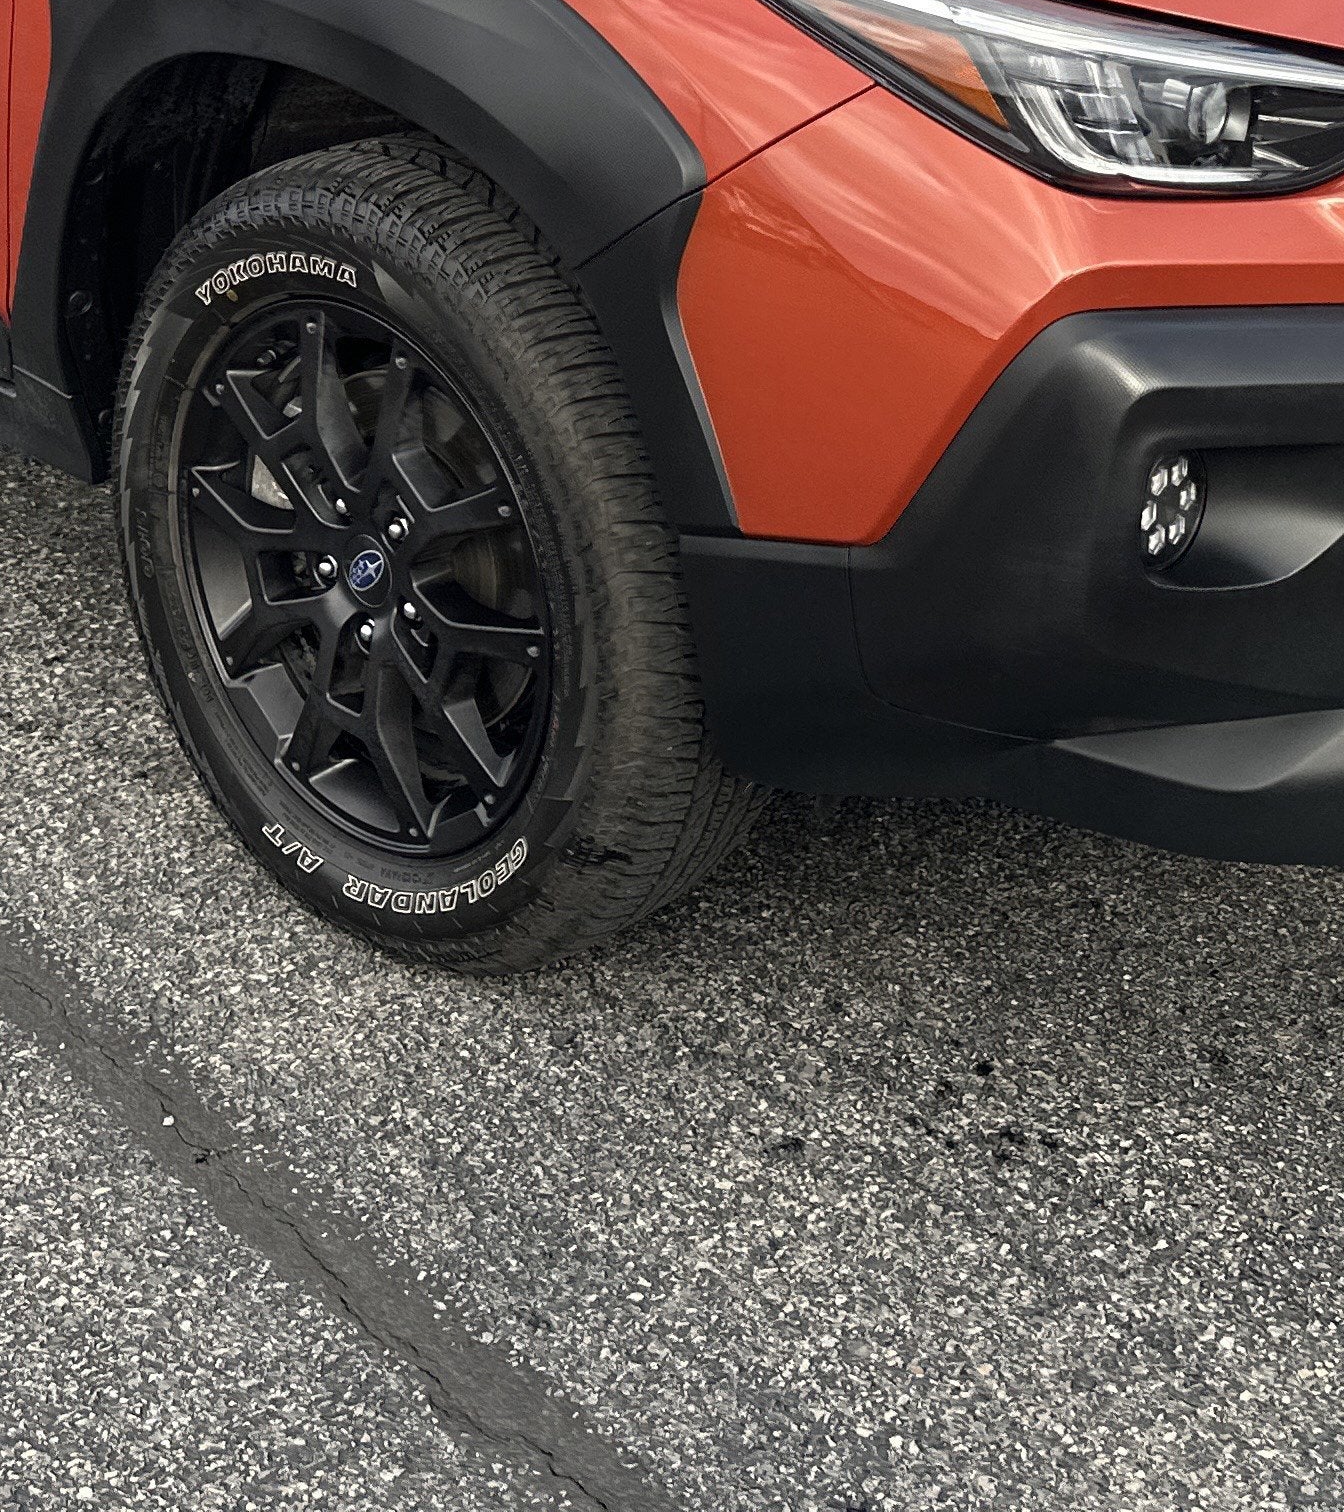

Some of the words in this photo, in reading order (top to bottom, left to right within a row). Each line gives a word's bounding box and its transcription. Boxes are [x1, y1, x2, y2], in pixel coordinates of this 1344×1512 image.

[195, 251, 357, 306] YOKOHAMA
[262, 823, 325, 873] A/T
[342, 835, 528, 914] GEOLANDAR
